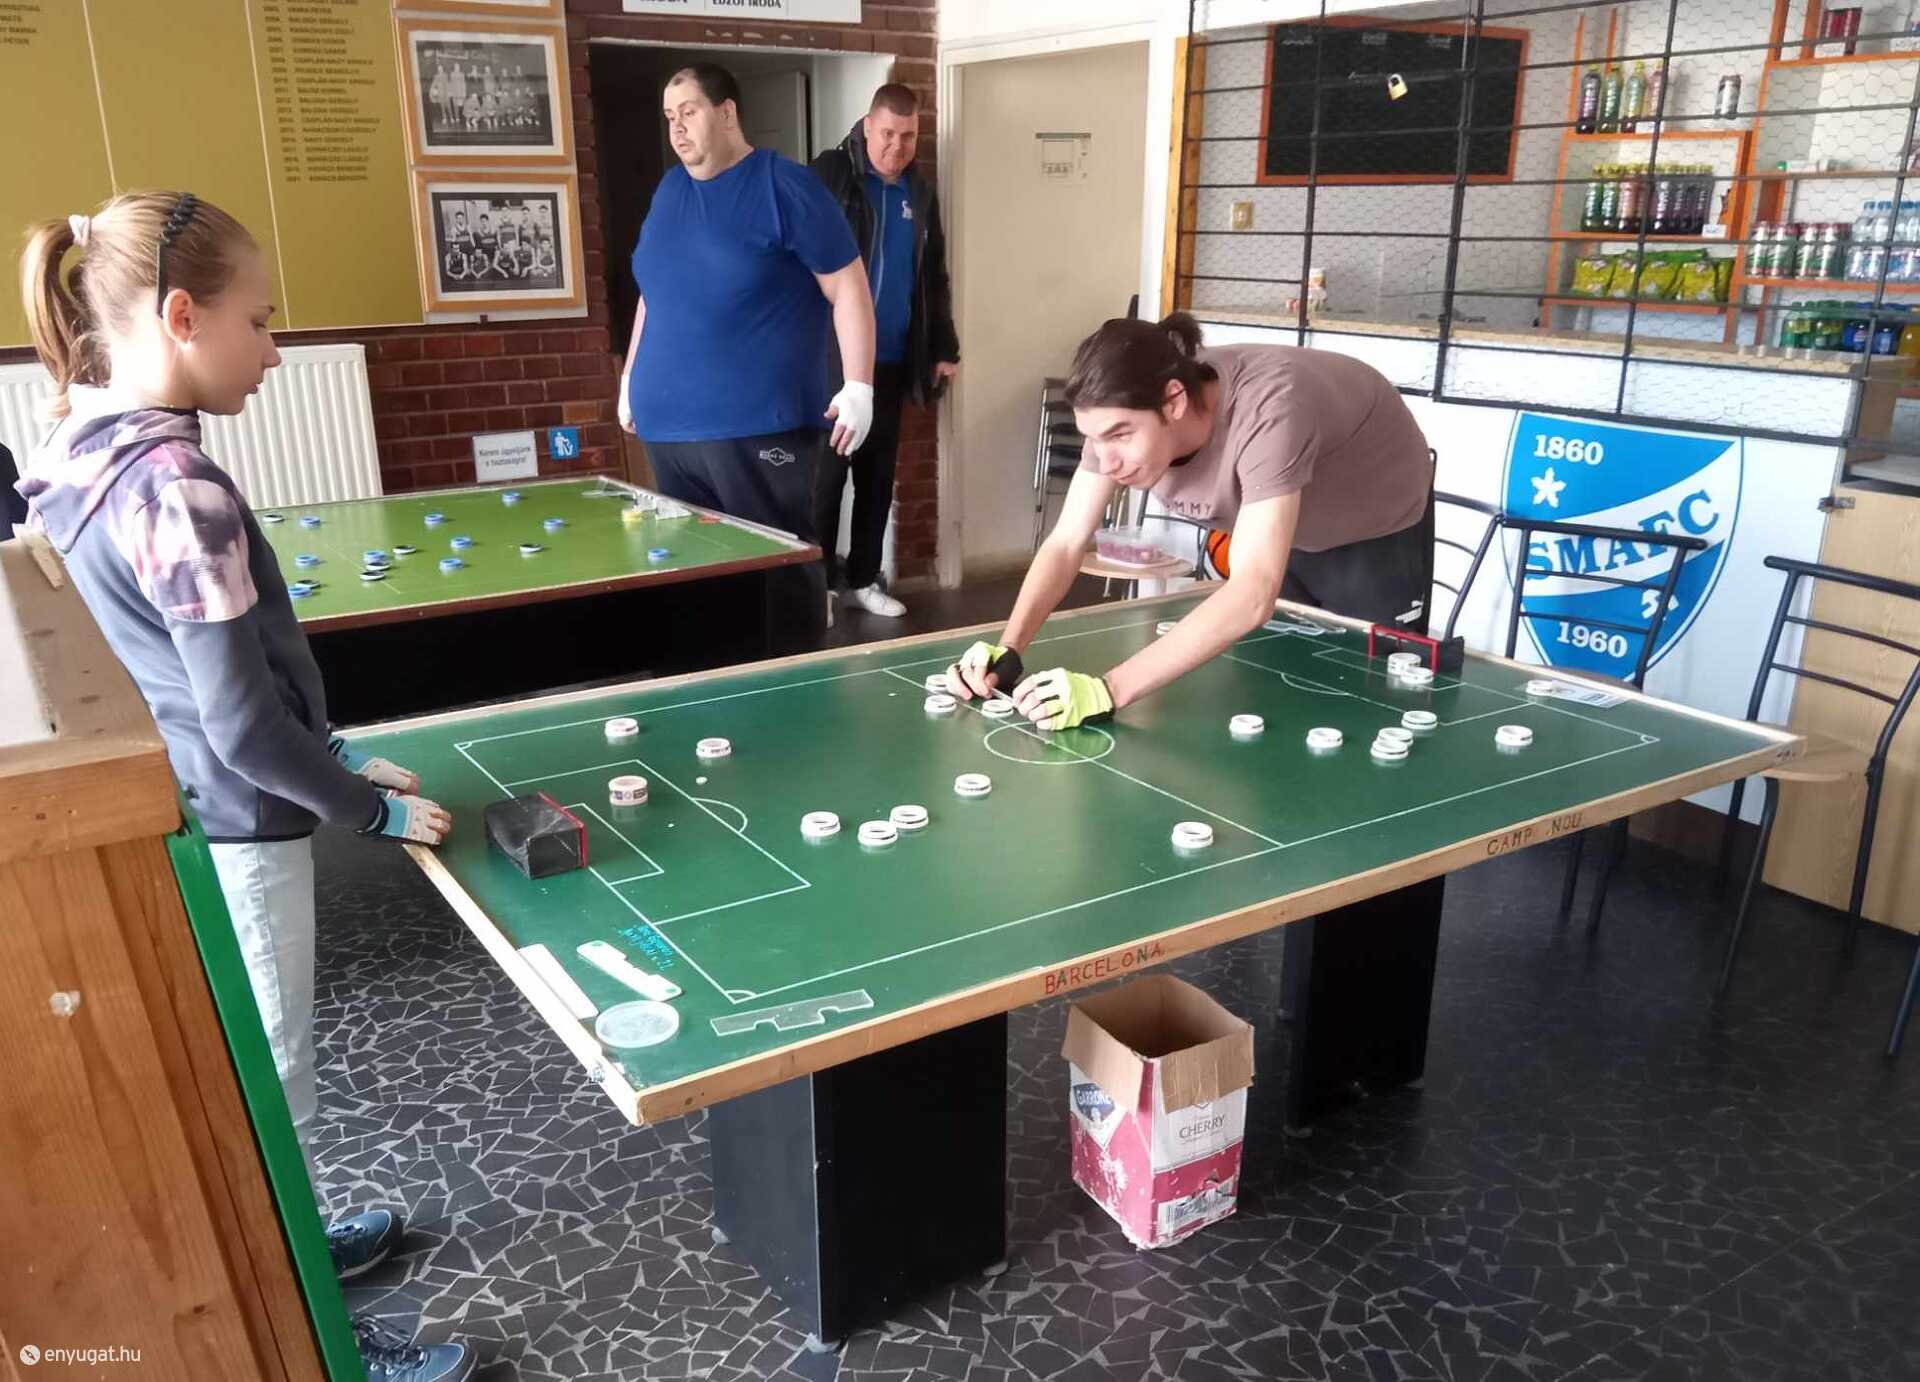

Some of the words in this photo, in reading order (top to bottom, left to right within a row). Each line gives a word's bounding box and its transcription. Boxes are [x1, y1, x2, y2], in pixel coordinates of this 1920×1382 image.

[1533, 434, 1604, 466] 1860
[1556, 622, 1629, 659] 1960
[1487, 827, 1533, 856] CAMP
[1044, 941, 1163, 995] BARCELONA
[1179, 1114, 1226, 1140] CHERRY
